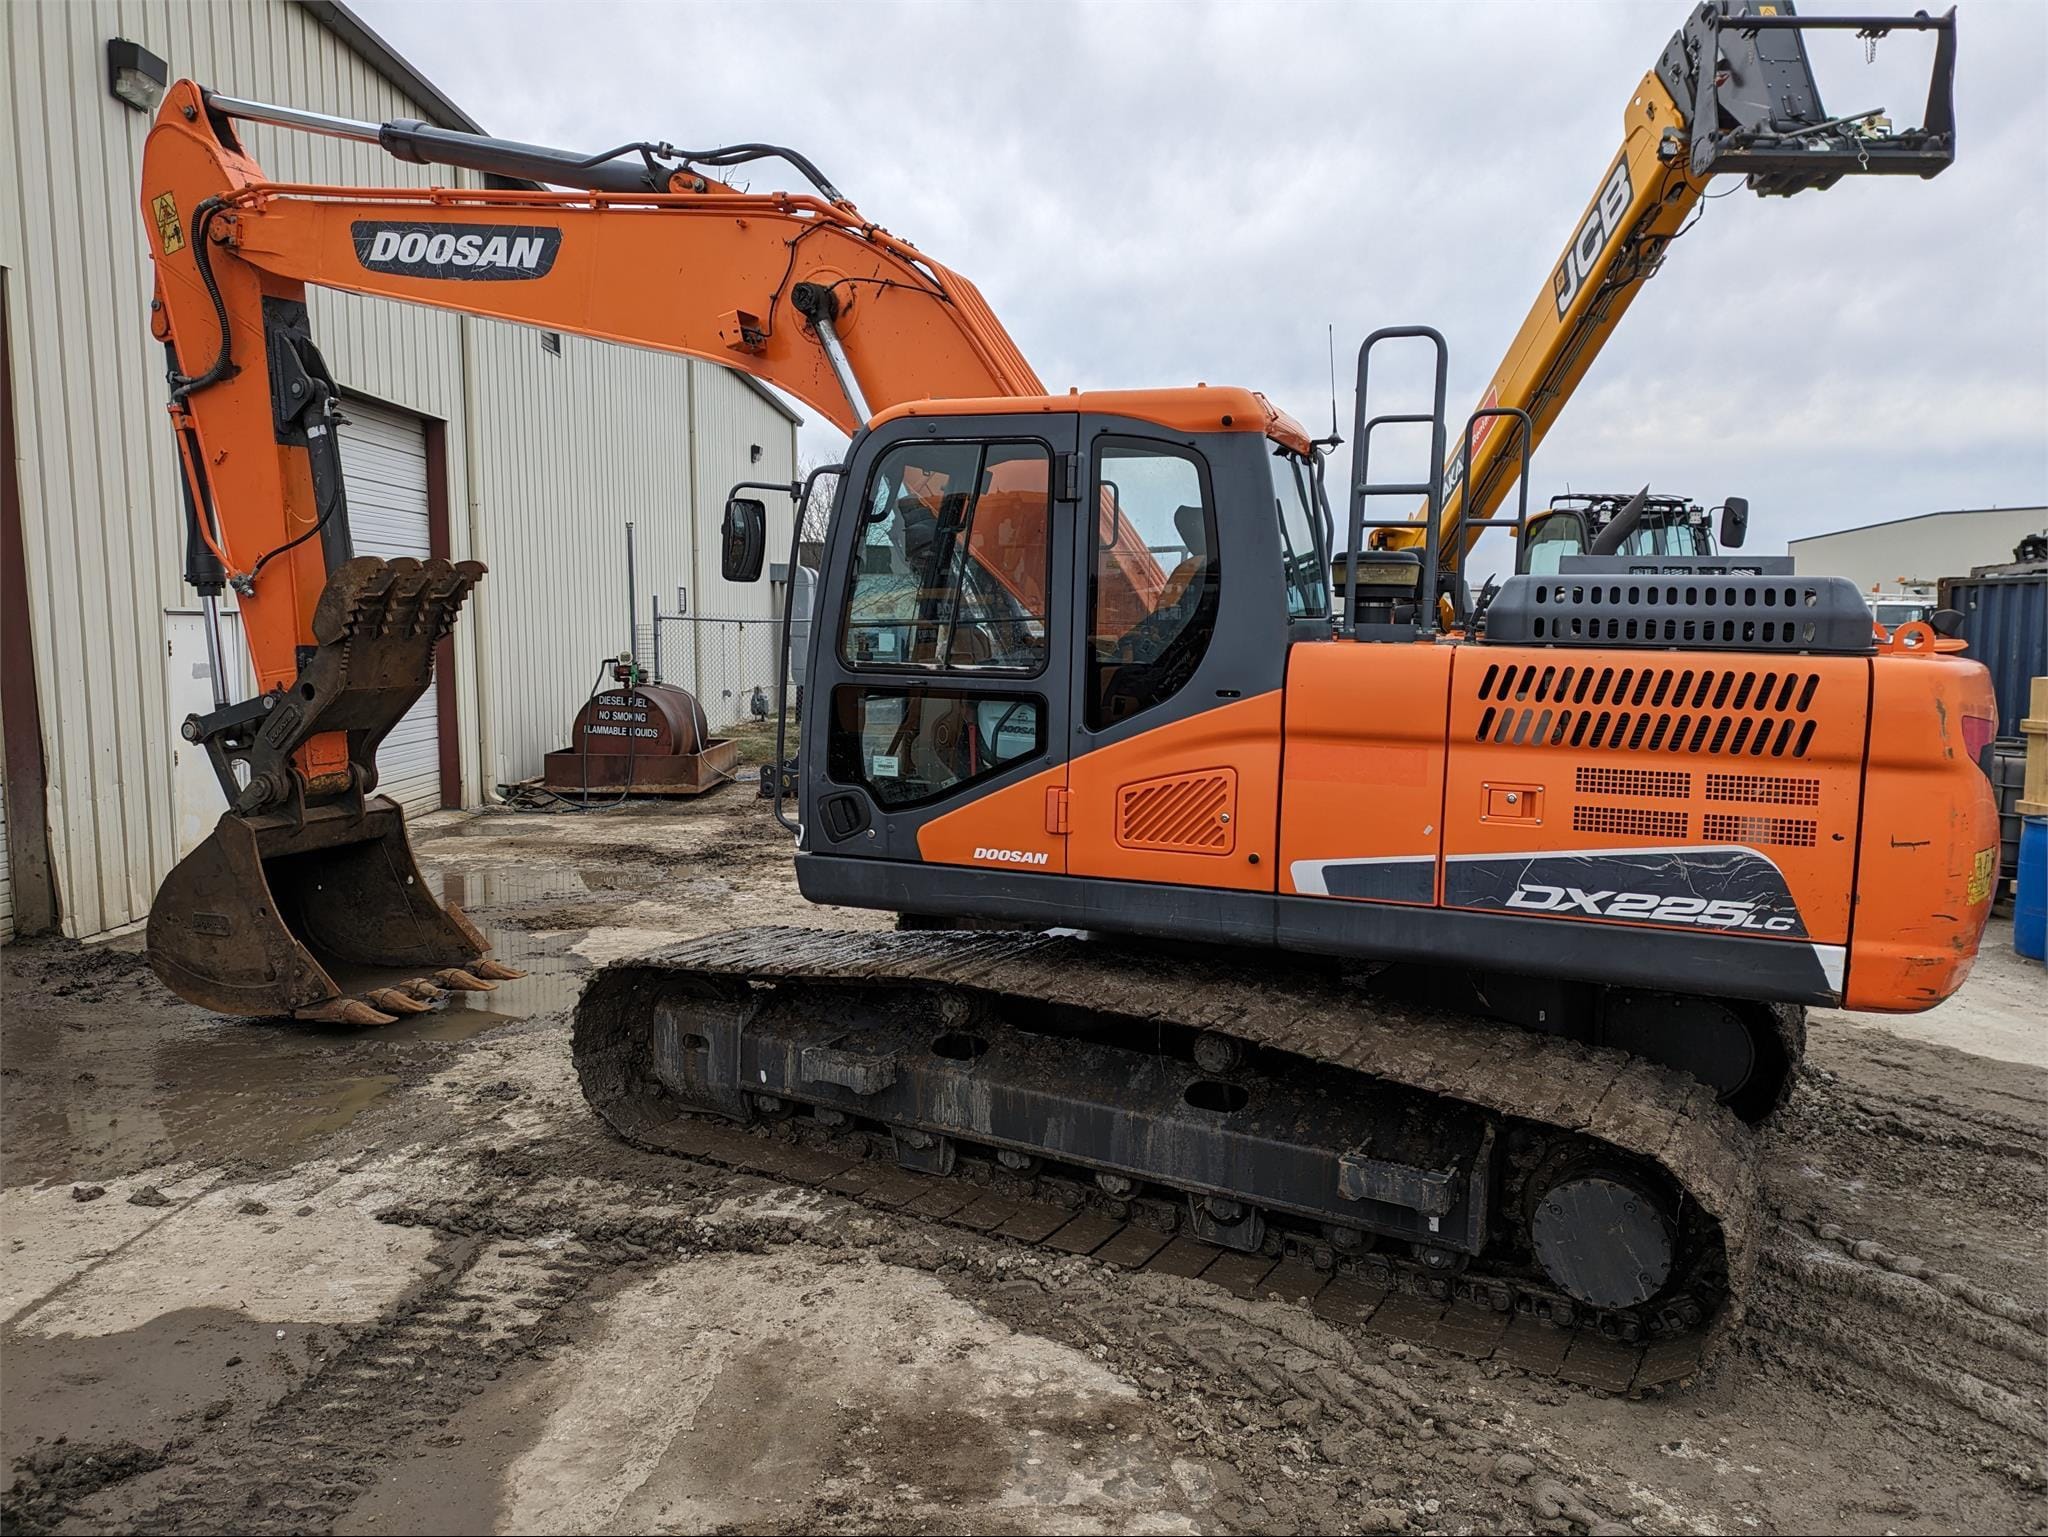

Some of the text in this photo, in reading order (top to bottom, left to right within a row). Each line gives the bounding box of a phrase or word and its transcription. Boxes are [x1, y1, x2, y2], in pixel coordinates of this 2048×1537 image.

[1558, 163, 1631, 313] JCB
[369, 231, 545, 268] DOOSAN
[598, 695, 626, 706] DIESEL
[598, 710, 646, 722] NO SMOKNG
[629, 727, 658, 738] LQUIDS
[973, 847, 1049, 865] DOOSAN
